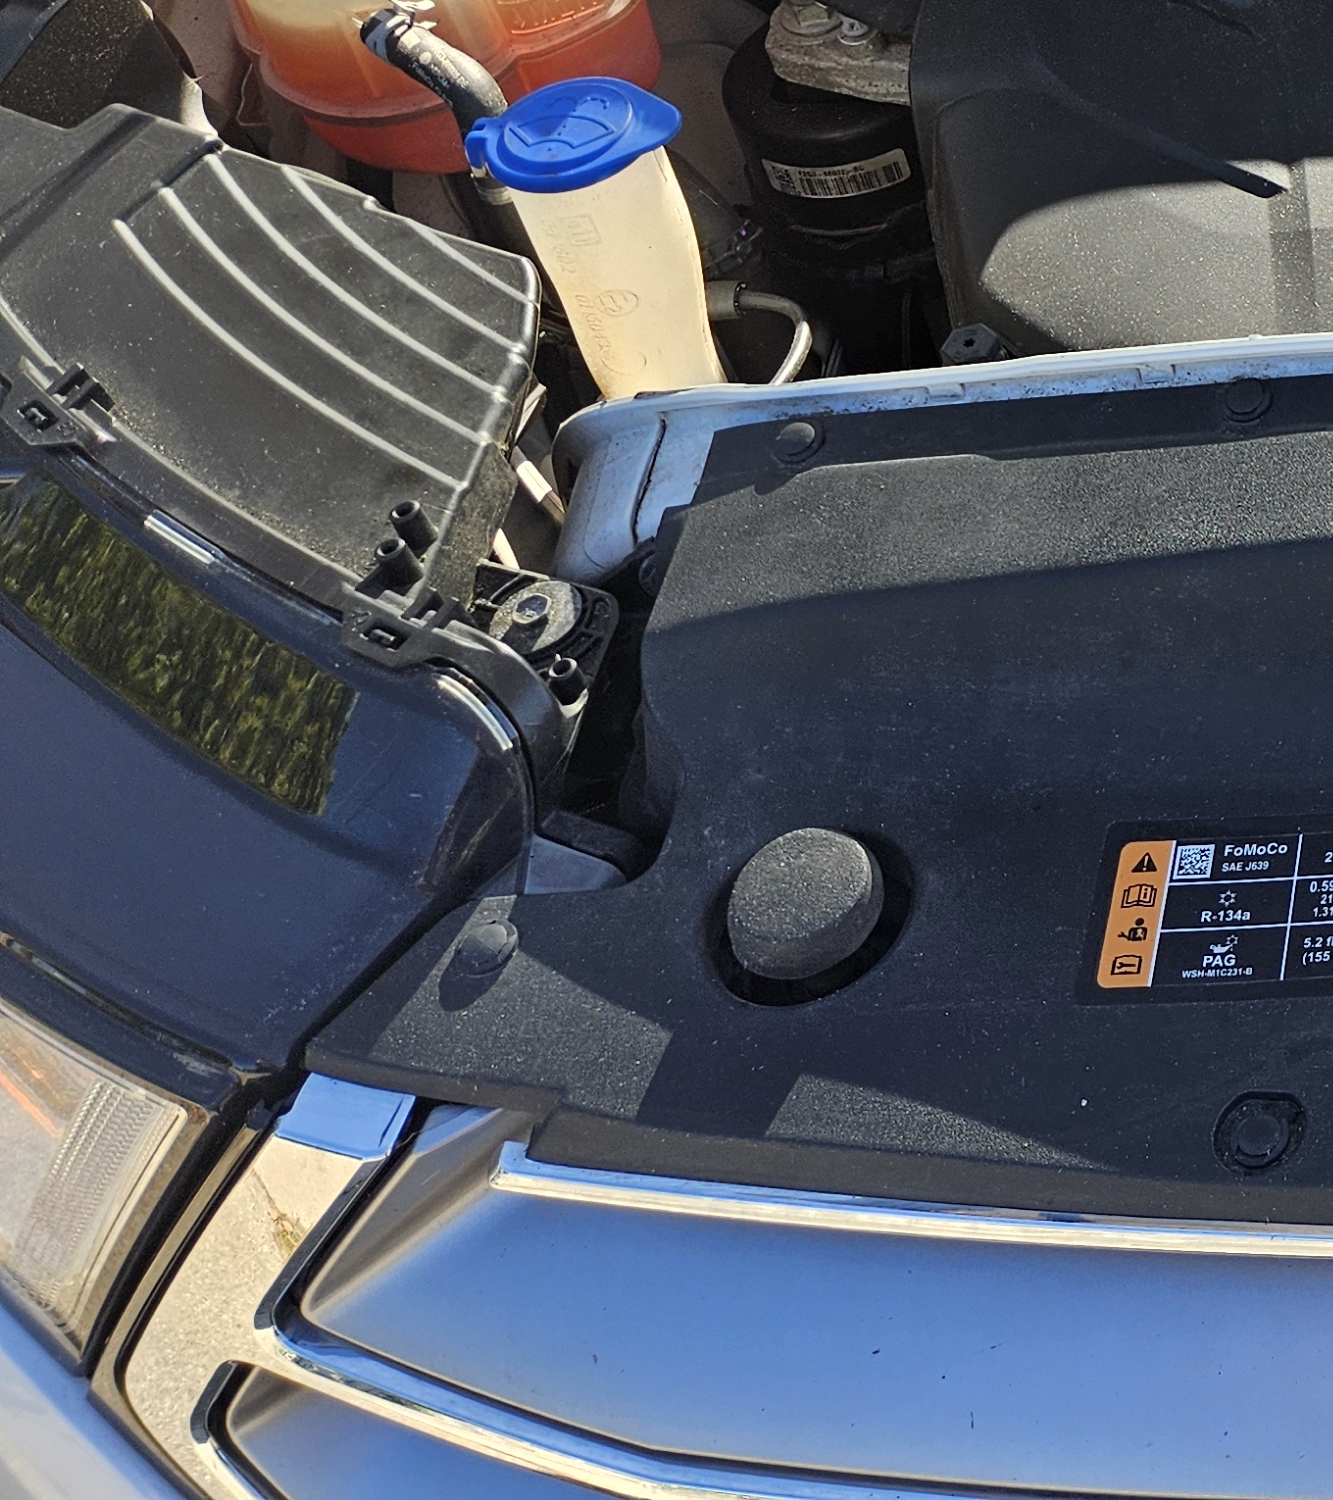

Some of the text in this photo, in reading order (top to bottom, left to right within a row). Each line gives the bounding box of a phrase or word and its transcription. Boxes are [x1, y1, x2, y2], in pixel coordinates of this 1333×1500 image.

[1223, 842, 1288, 857] FoMoCo
[1221, 861, 1270, 872] SAE J639
[1320, 894, 1333, 905] 21
[1200, 910, 1251, 923] R-134a
[1312, 907, 1333, 918] 1.31
[1303, 937, 1323, 949] 5.2
[1202, 954, 1237, 968] PAG
[1302, 952, 1330, 966] (155
